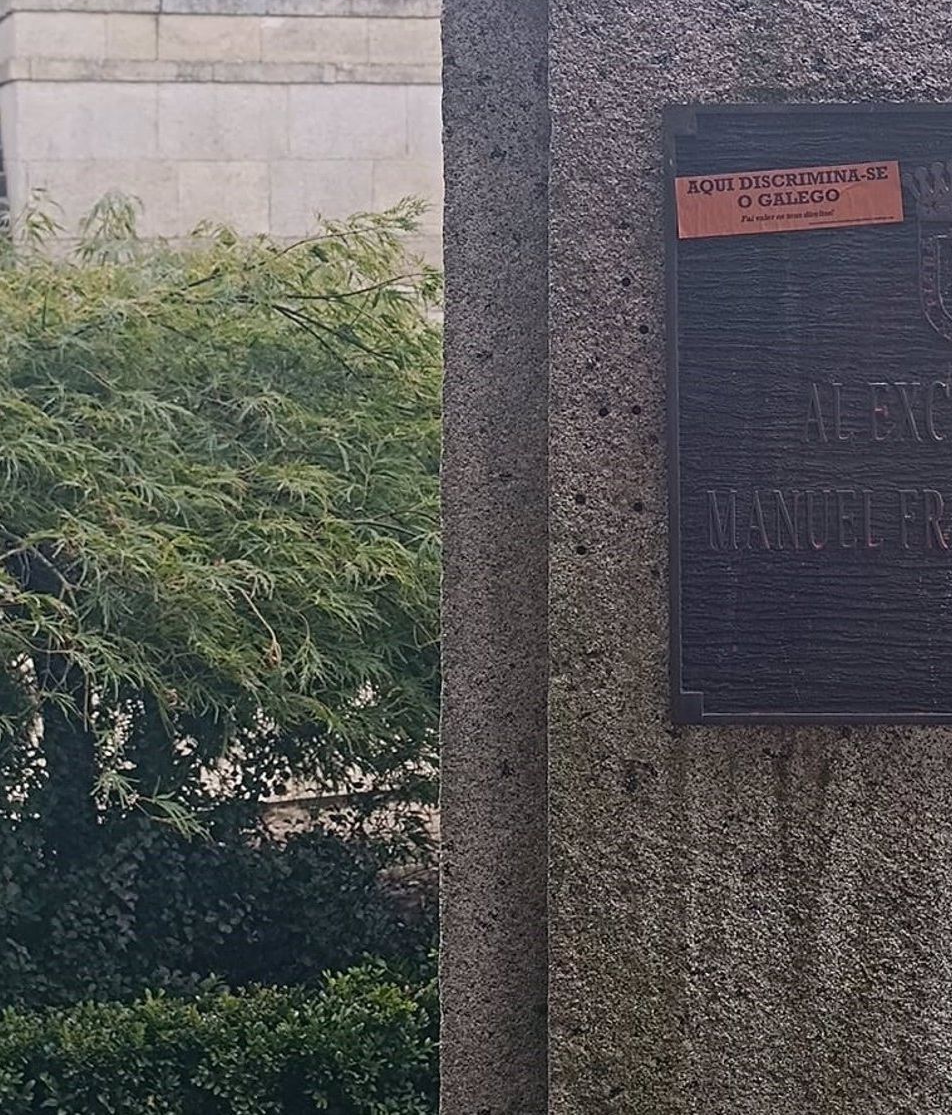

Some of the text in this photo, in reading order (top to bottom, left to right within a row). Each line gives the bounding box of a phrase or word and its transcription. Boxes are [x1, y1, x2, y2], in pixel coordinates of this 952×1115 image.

[686, 166, 889, 195] AQUI DISCRIMINA-SE
[738, 189, 841, 209] O GALEGO
[802, 382, 854, 442] AL
[704, 487, 884, 551] MANUEL
